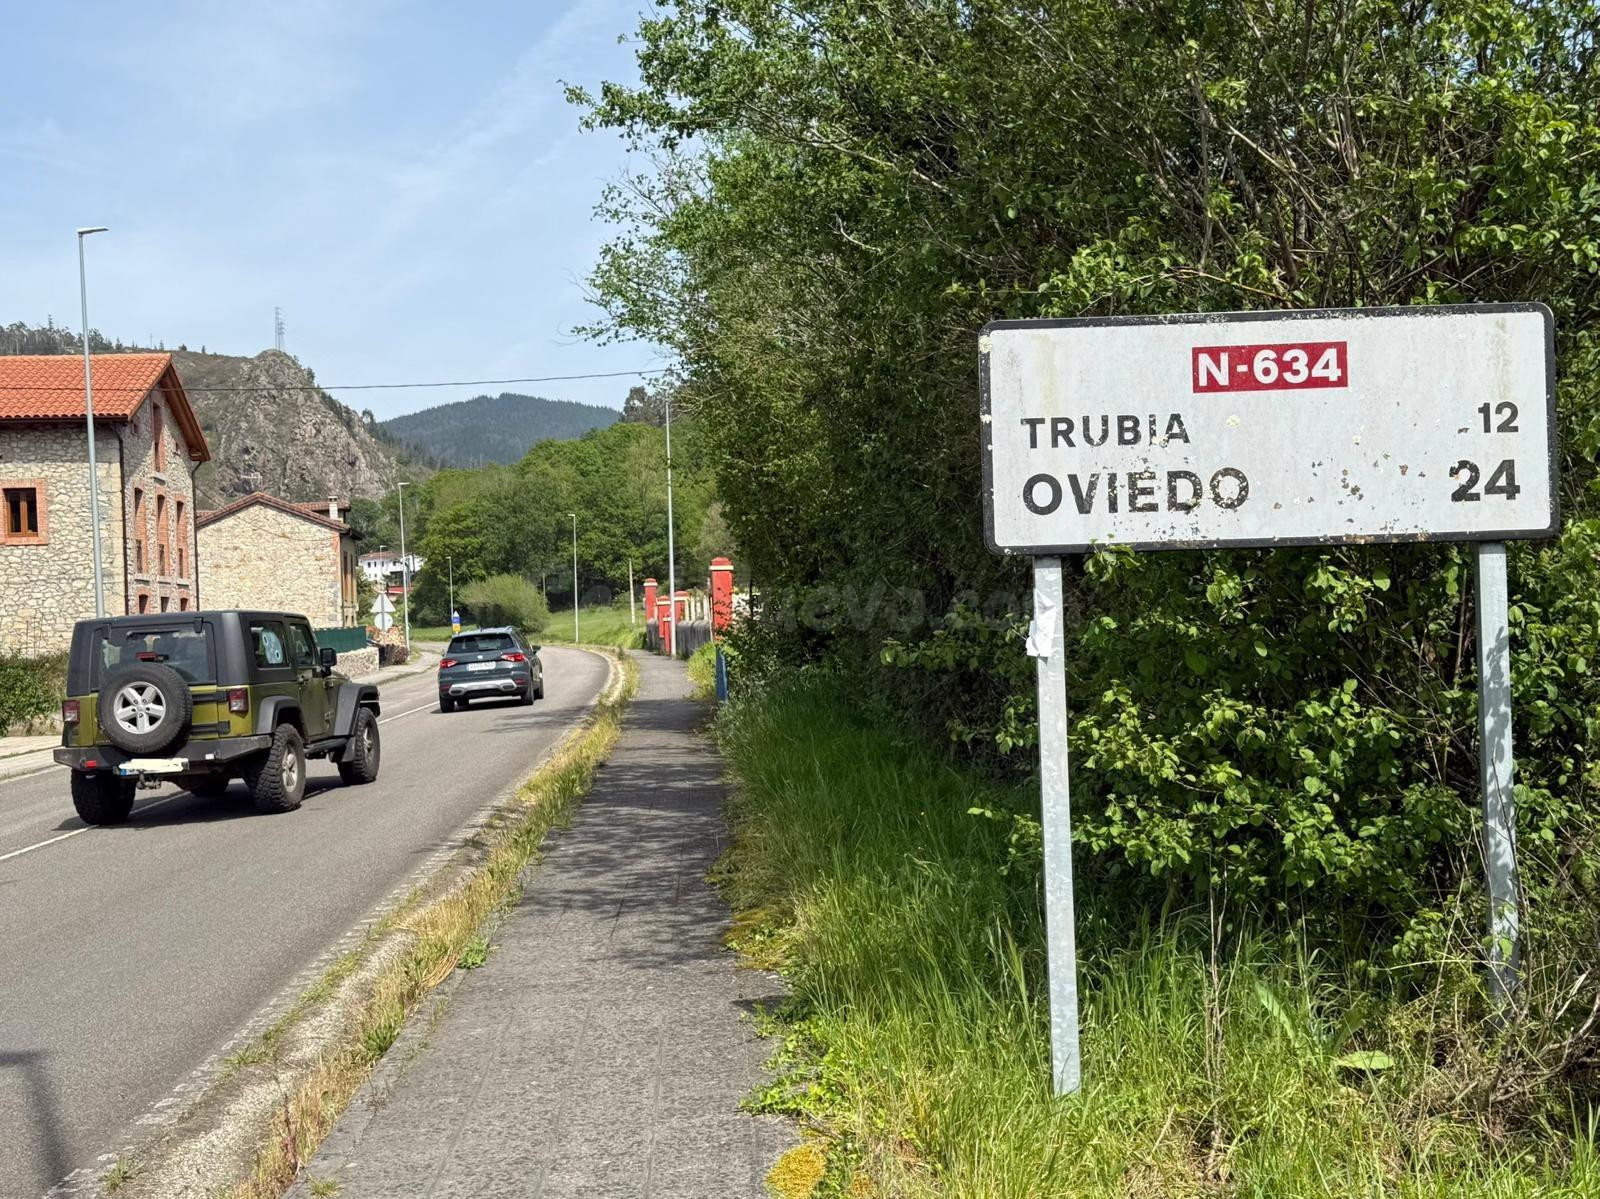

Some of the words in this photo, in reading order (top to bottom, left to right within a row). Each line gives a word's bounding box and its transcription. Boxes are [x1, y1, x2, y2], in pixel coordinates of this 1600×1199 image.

[1197, 347, 1342, 387] N-634
[1020, 413, 1191, 449] TRUBIA
[1478, 402, 1519, 433] 12
[1023, 467, 1249, 516] OVIEDO
[1449, 459, 1521, 502] 24
